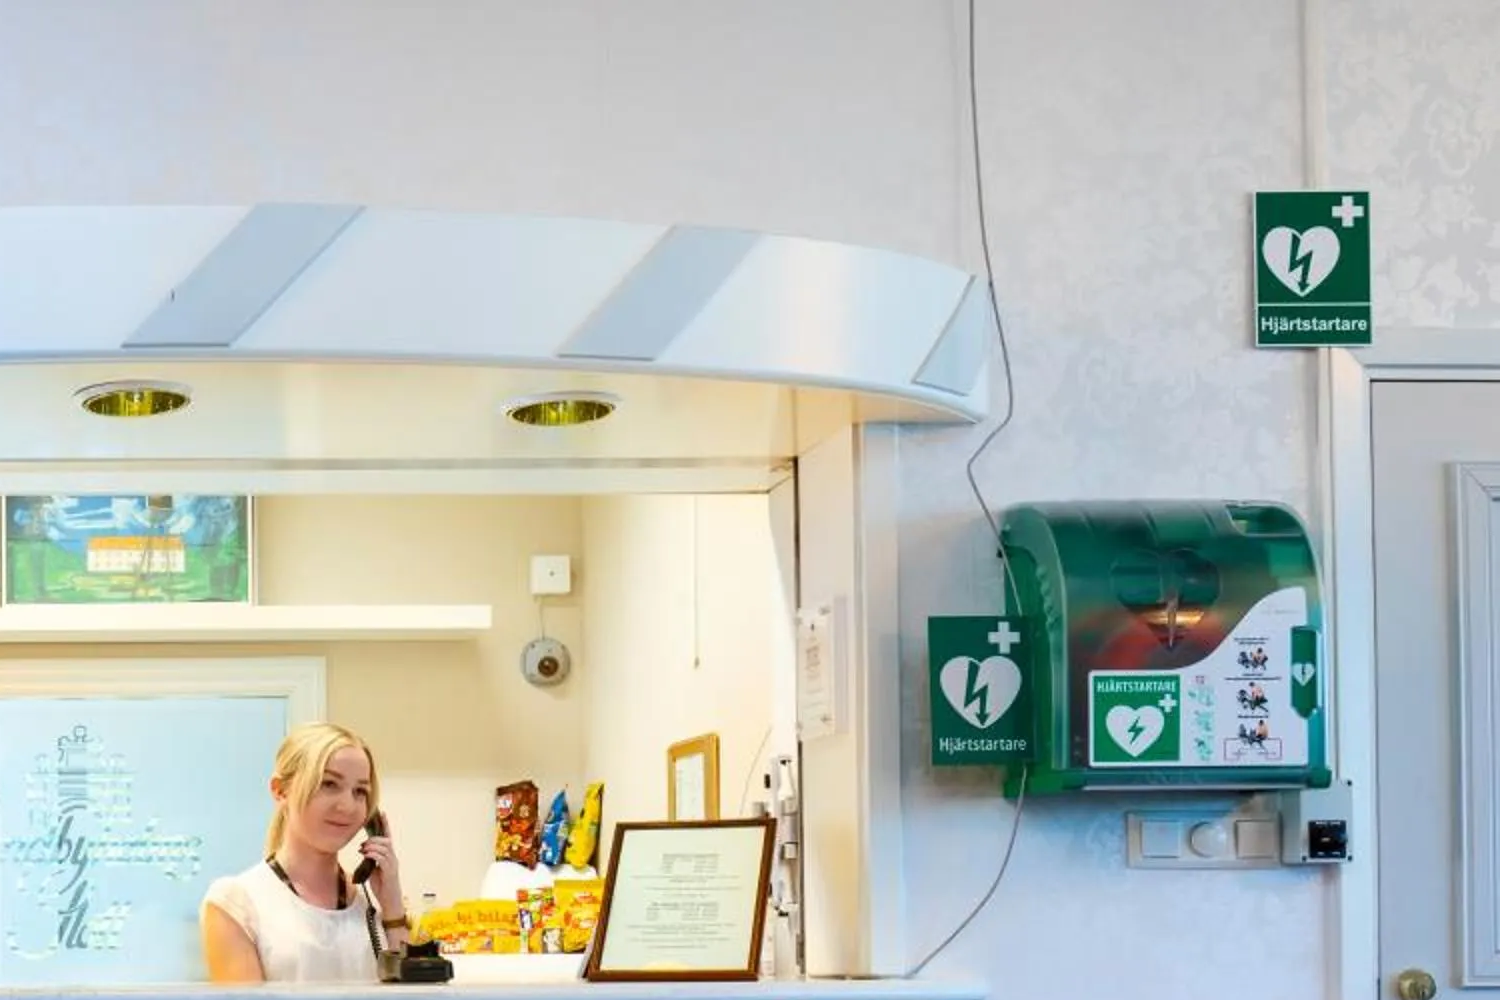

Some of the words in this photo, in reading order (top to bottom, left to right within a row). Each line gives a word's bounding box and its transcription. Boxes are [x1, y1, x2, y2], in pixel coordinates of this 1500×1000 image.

[1261, 316, 1367, 335] Hjärtstartare
[1096, 679, 1176, 693] HJÄRTSTARTARE
[939, 737, 1027, 755] Hjärtstartare
